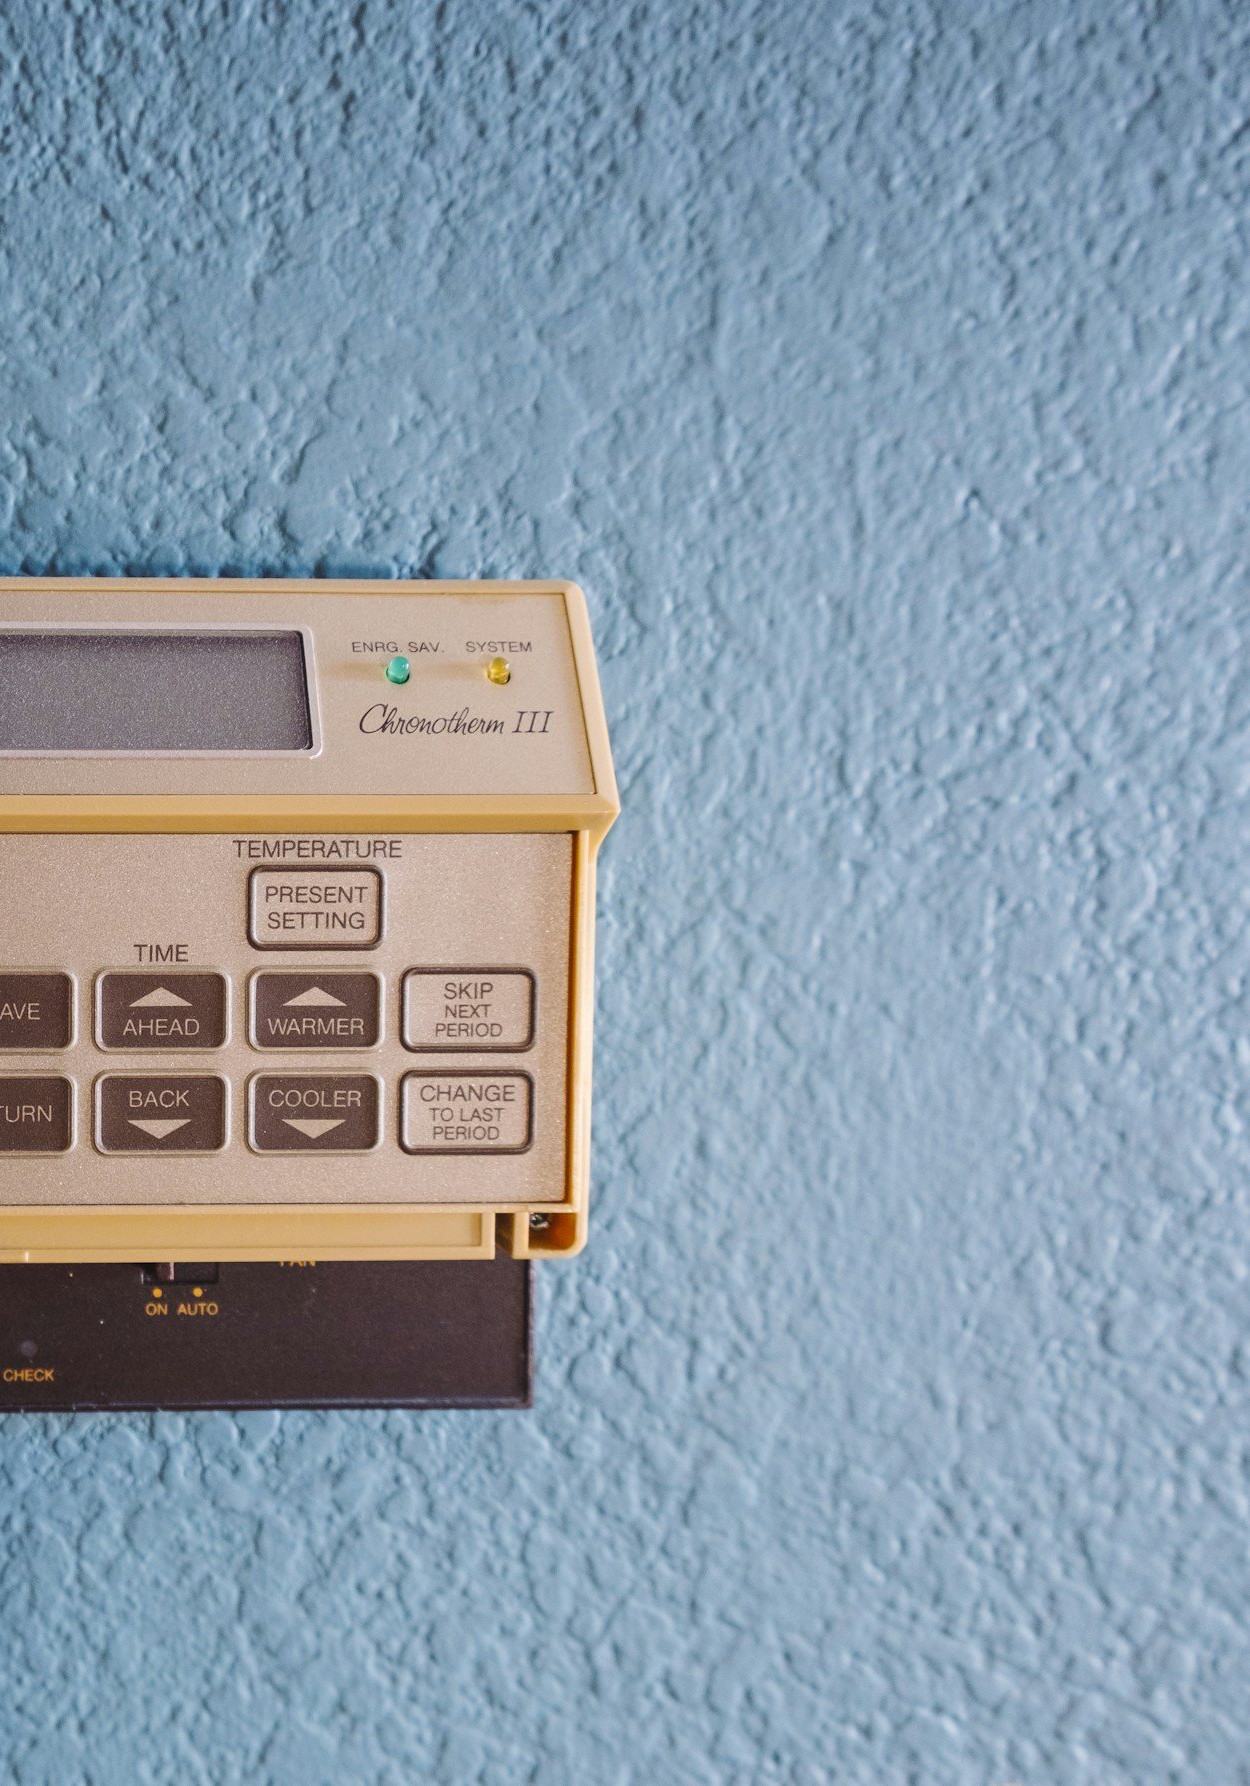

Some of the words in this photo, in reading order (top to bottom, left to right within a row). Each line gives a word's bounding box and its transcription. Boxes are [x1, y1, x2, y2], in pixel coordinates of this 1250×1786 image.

[351, 641, 403, 653] ENRG.
[408, 641, 445, 653] SAV.
[465, 641, 533, 653] SYSTEM
[359, 703, 505, 735] Chronotherm
[511, 711, 555, 735] III
[233, 839, 403, 858] TEMPERATURE
[264, 885, 369, 903] PRESENT
[266, 911, 366, 929] SETTING
[133, 944, 190, 962] TIME
[443, 982, 494, 999] SKIP
[444, 1004, 492, 1019] NEXT
[122, 1017, 201, 1036] AHEAD
[267, 1017, 366, 1035] WARMER
[434, 1022, 504, 1039] PERIOD
[128, 1090, 191, 1108] BACK
[268, 1090, 362, 1108] COOLER
[419, 1084, 516, 1102] CHANGE
[428, 1107, 453, 1123] TO
[458, 1107, 505, 1123] LAST
[432, 1126, 500, 1142] PERIOD
[144, 1303, 169, 1318] ON
[176, 1303, 220, 1318] AUTO
[2, 1368, 56, 1383] CHECK
